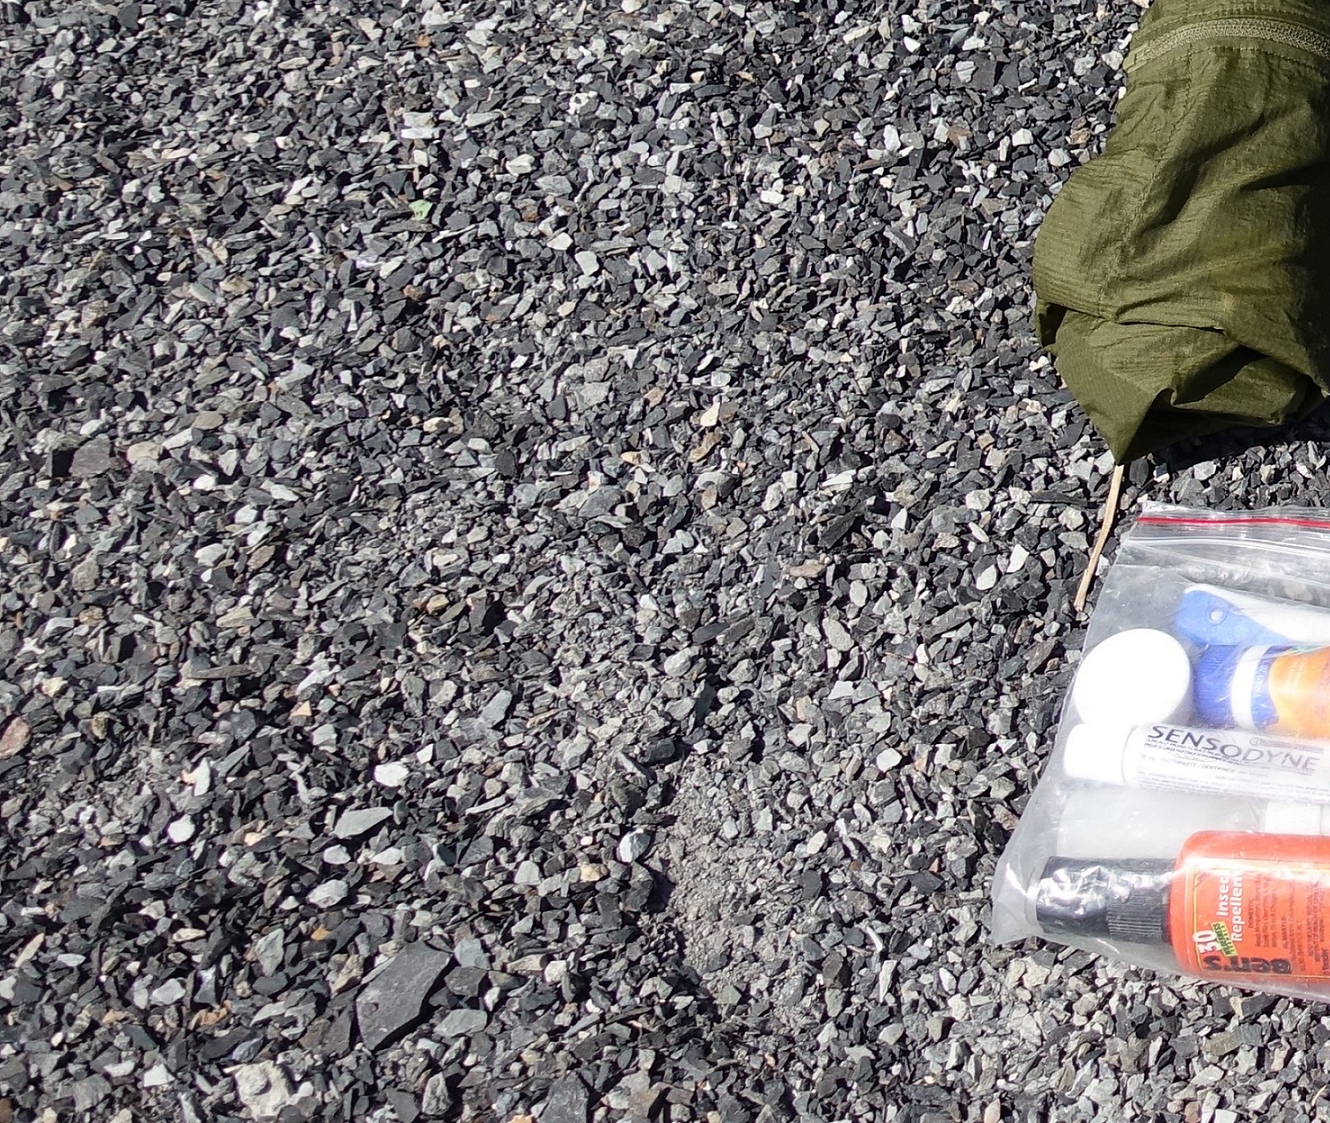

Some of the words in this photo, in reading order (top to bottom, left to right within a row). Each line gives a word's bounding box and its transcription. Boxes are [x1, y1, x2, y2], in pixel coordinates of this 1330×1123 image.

[1147, 725, 1320, 772] SENSODYNE
[1192, 929, 1222, 955] 30
[1202, 954, 1293, 975] Ben's
